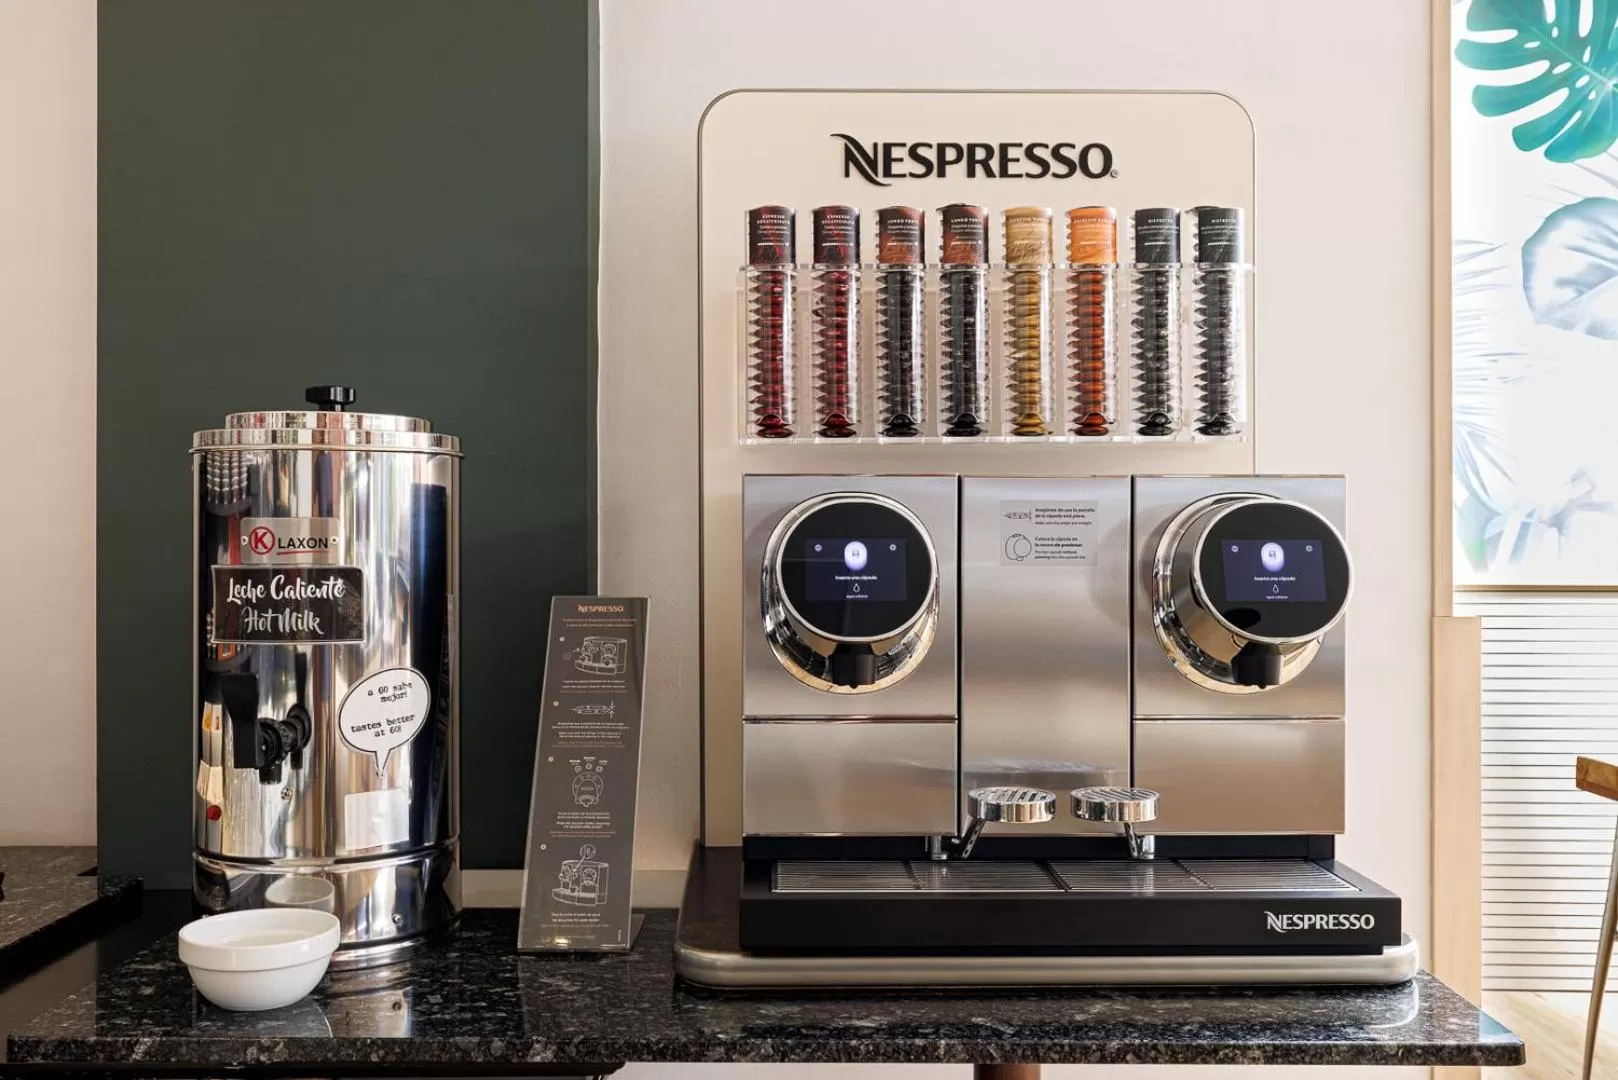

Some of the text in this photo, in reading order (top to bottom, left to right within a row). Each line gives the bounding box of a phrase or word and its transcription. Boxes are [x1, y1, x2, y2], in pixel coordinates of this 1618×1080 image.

[829, 133, 1114, 186] NESPRESSO
[226, 574, 345, 604] Leche Caliente
[578, 604, 624, 613] NESPRESSO
[242, 606, 324, 635] Hot Milk
[378, 685, 389, 694] 60
[350, 713, 415, 733] tastes better
[374, 729, 385, 737] at
[1263, 910, 1375, 933] NESPRESSO
